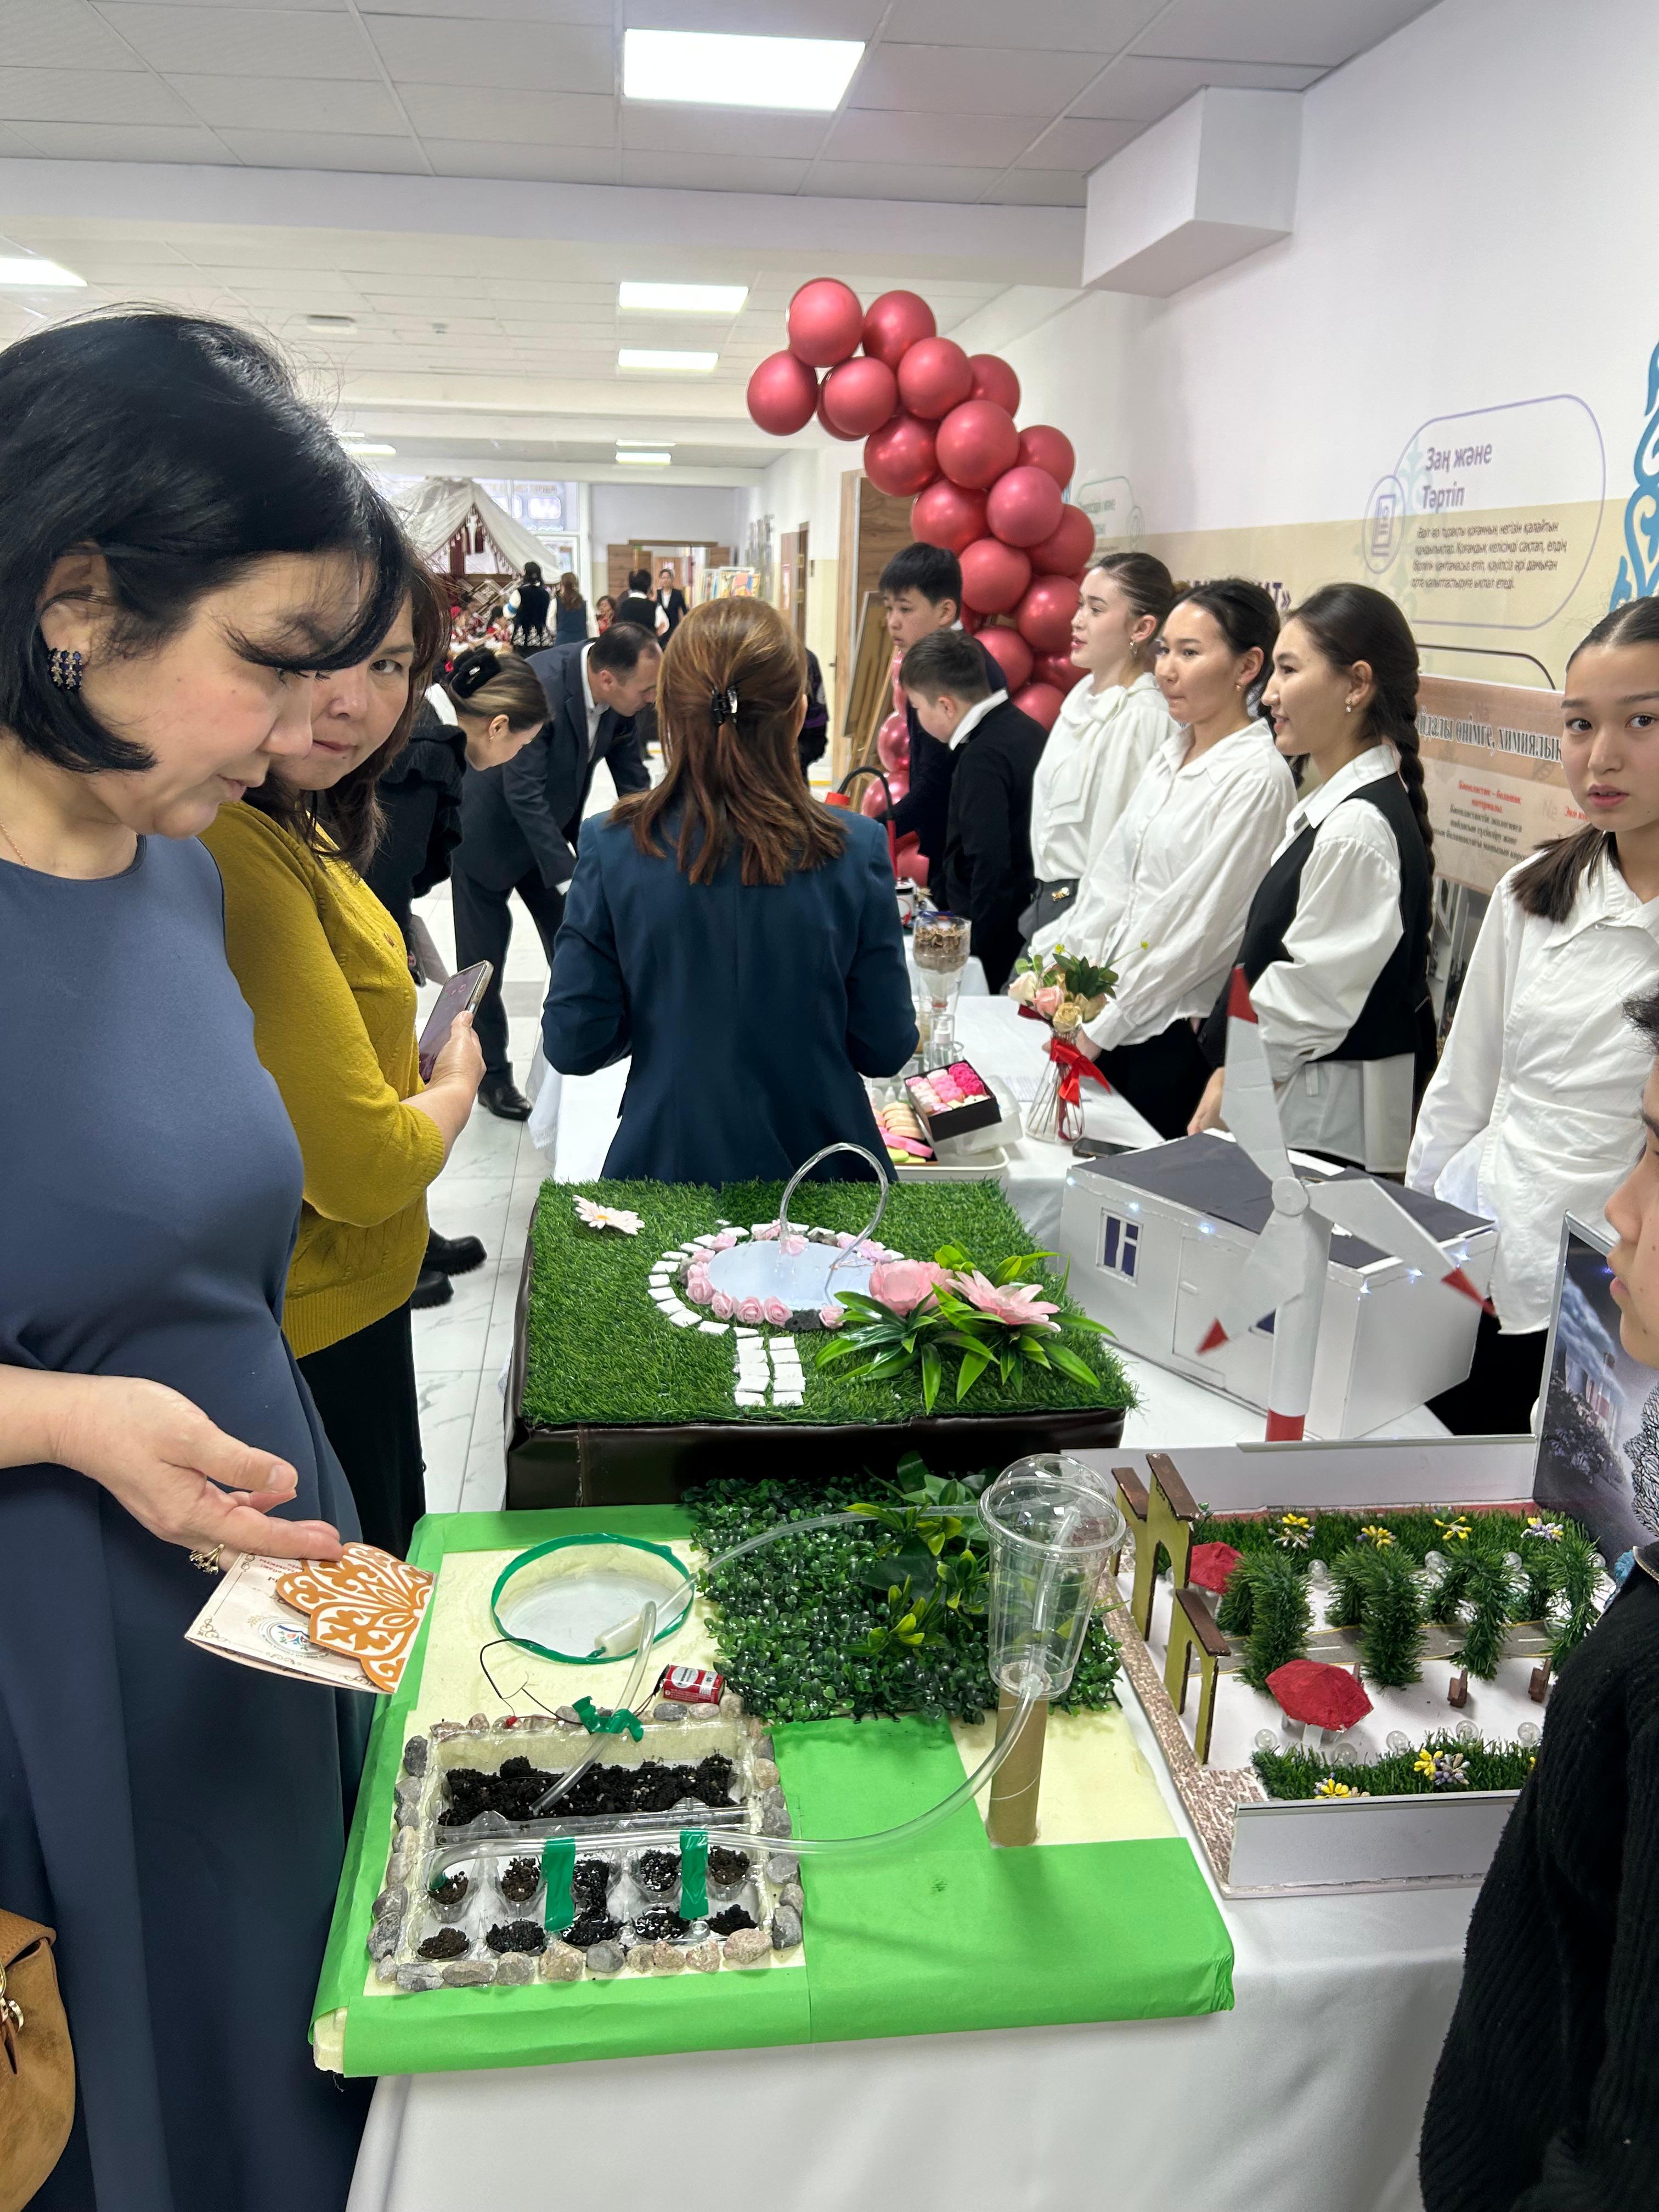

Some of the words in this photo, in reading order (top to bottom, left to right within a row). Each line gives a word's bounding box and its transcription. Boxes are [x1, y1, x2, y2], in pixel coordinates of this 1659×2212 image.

[1426, 447, 1451, 473] Заң
[1453, 443, 1492, 469] және
[1422, 481, 1465, 514] Тәртіп
[1457, 713, 1496, 756] өнімге,
